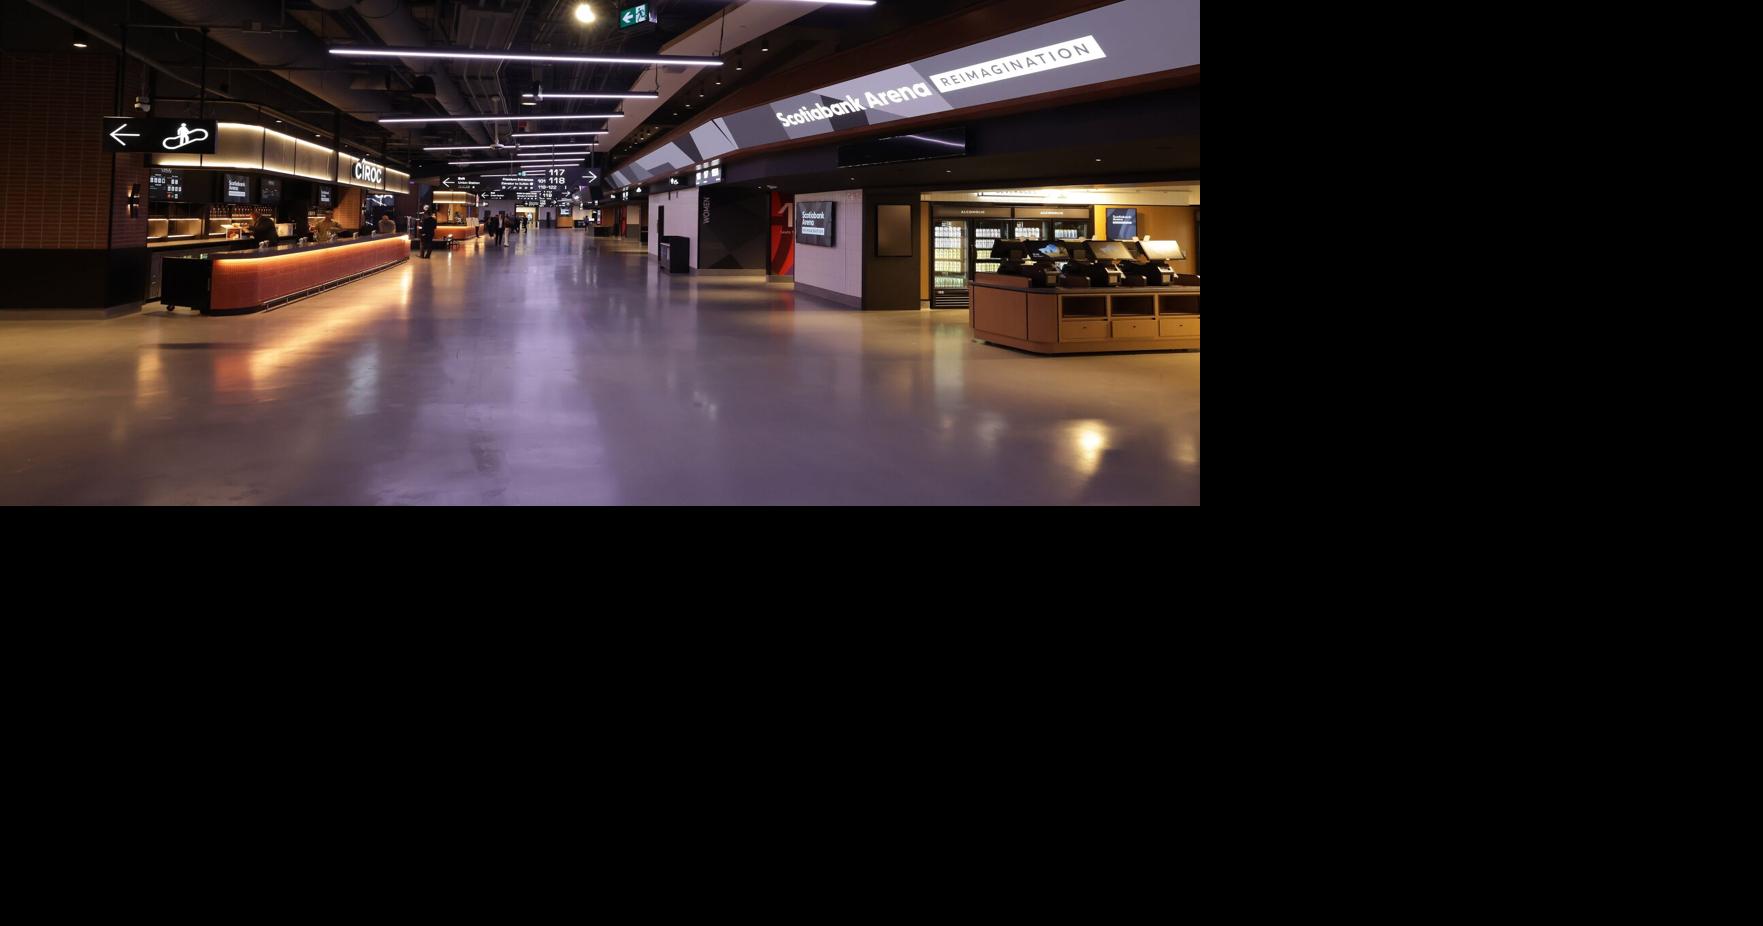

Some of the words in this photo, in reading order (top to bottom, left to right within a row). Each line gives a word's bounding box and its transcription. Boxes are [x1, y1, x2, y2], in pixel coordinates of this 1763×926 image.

[940, 43, 1090, 87] REIMAGINATION
[776, 95, 866, 128] Scotiabank
[866, 82, 933, 109] Arena
[702, 197, 711, 225] WOMEN
[801, 210, 824, 219] Scotiabank
[801, 218, 815, 226] Arena
